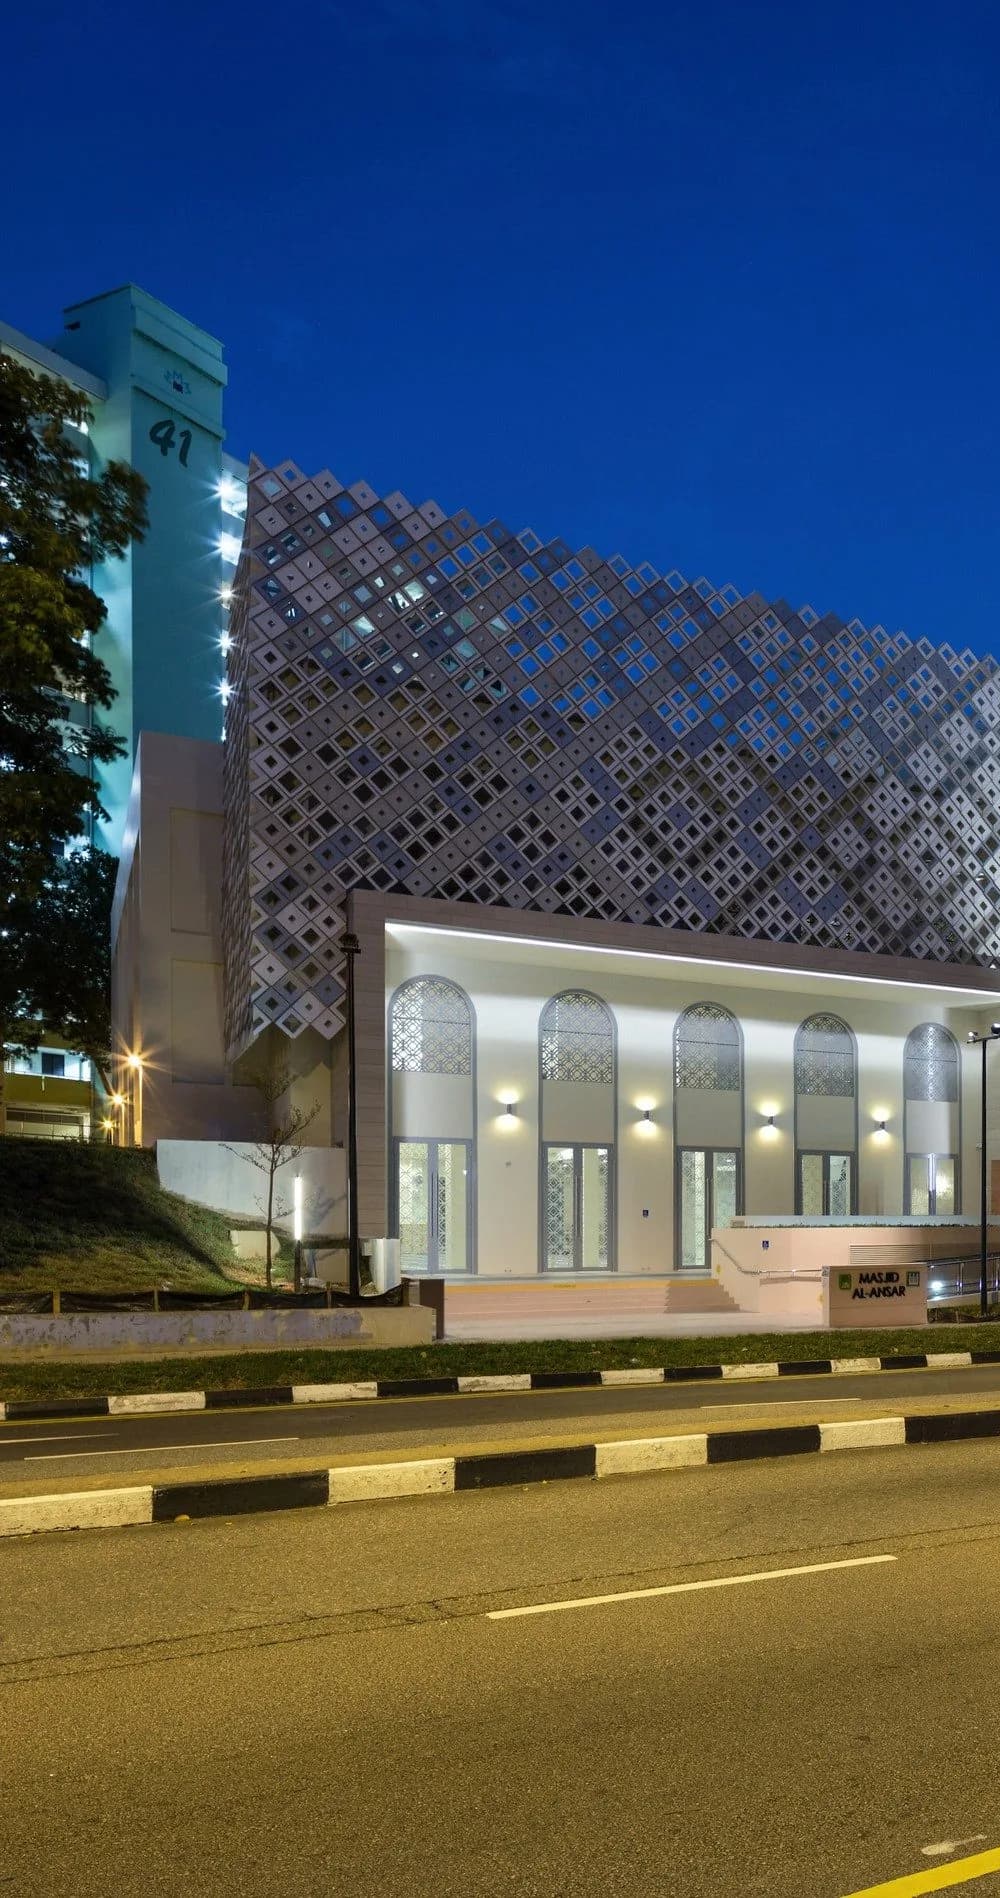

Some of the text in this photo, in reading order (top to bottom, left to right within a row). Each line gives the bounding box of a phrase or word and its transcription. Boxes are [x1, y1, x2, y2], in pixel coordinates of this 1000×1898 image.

[149, 419, 192, 468] 41
[858, 1271, 900, 1284] MASJID
[852, 1285, 906, 1300] AL-ANSAR
